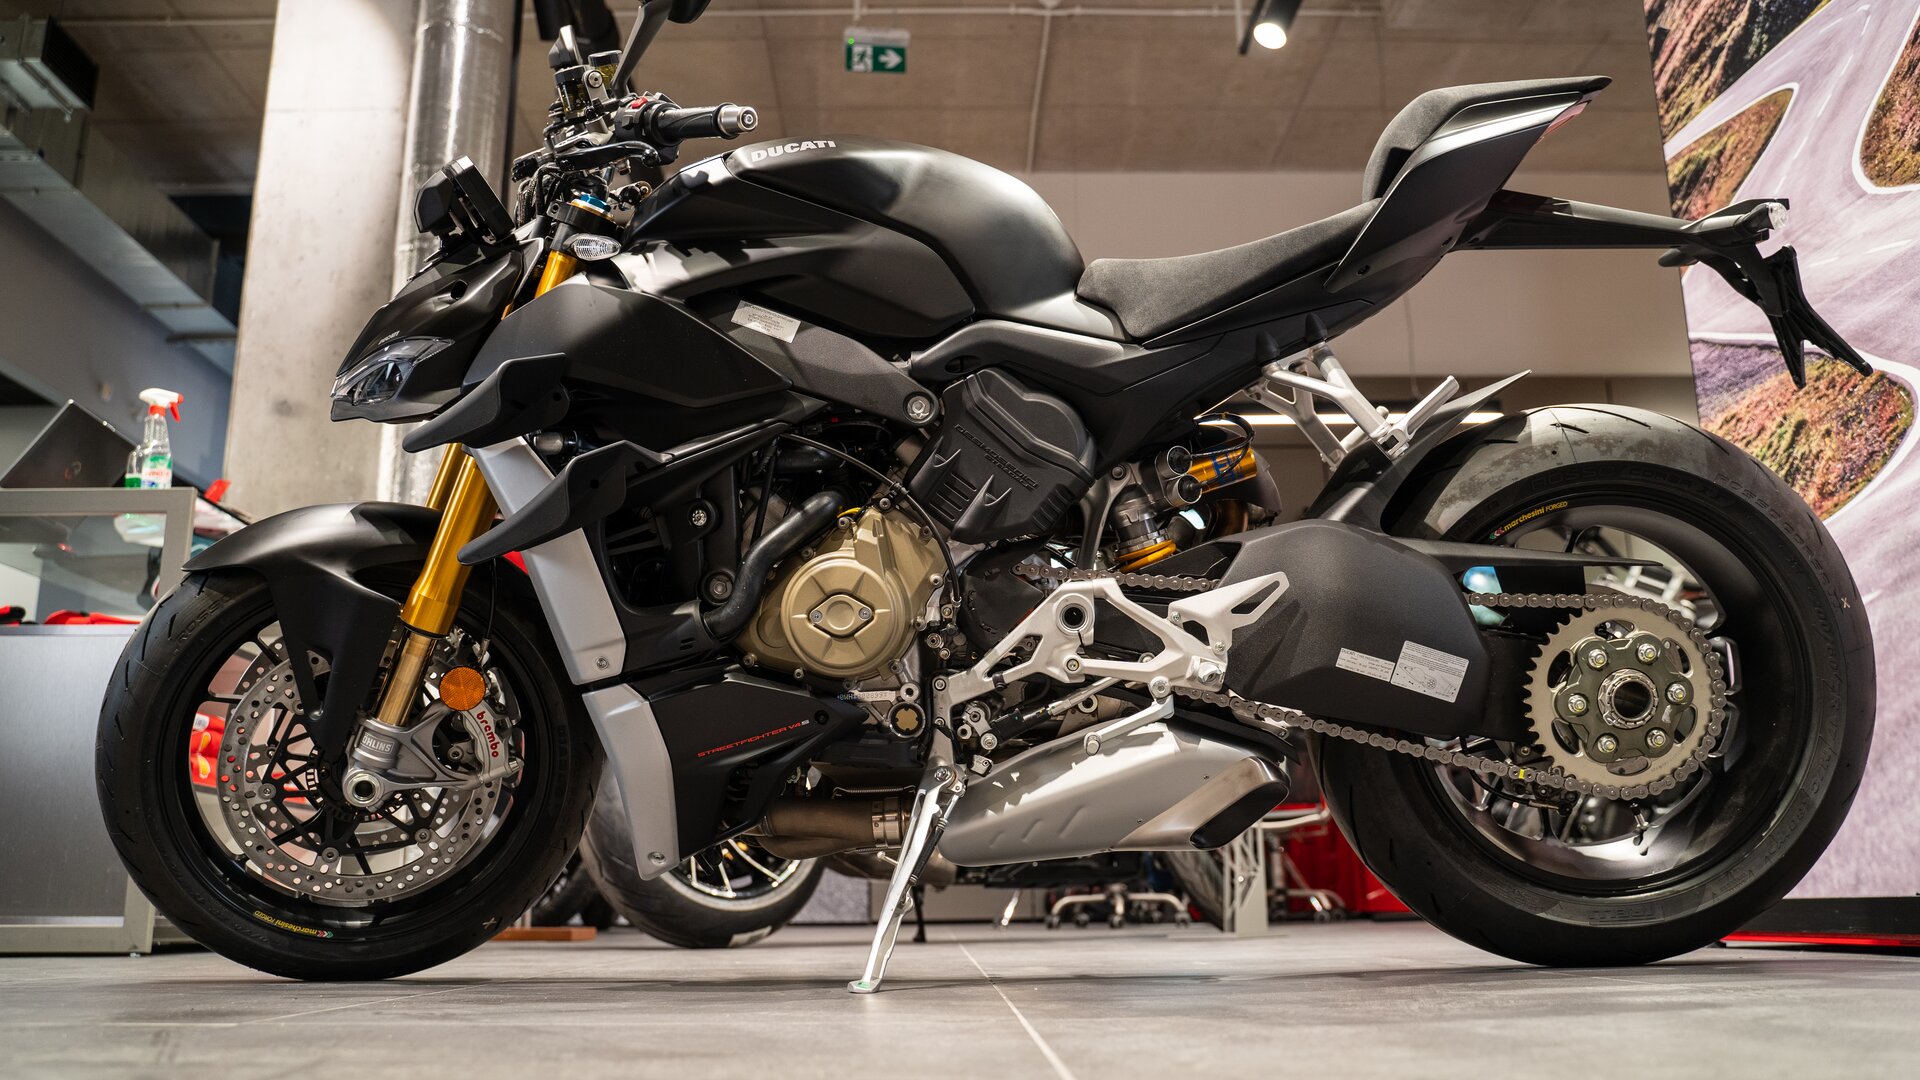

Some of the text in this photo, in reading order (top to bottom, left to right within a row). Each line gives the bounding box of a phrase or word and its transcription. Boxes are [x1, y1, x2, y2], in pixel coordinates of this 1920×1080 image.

[751, 141, 836, 162] DUCATI
[1503, 501, 1568, 532] marchesini FORGED
[477, 711, 500, 758] brembo
[697, 727, 787, 757] STREETFIGHTER
[276, 920, 318, 935] marchesini
